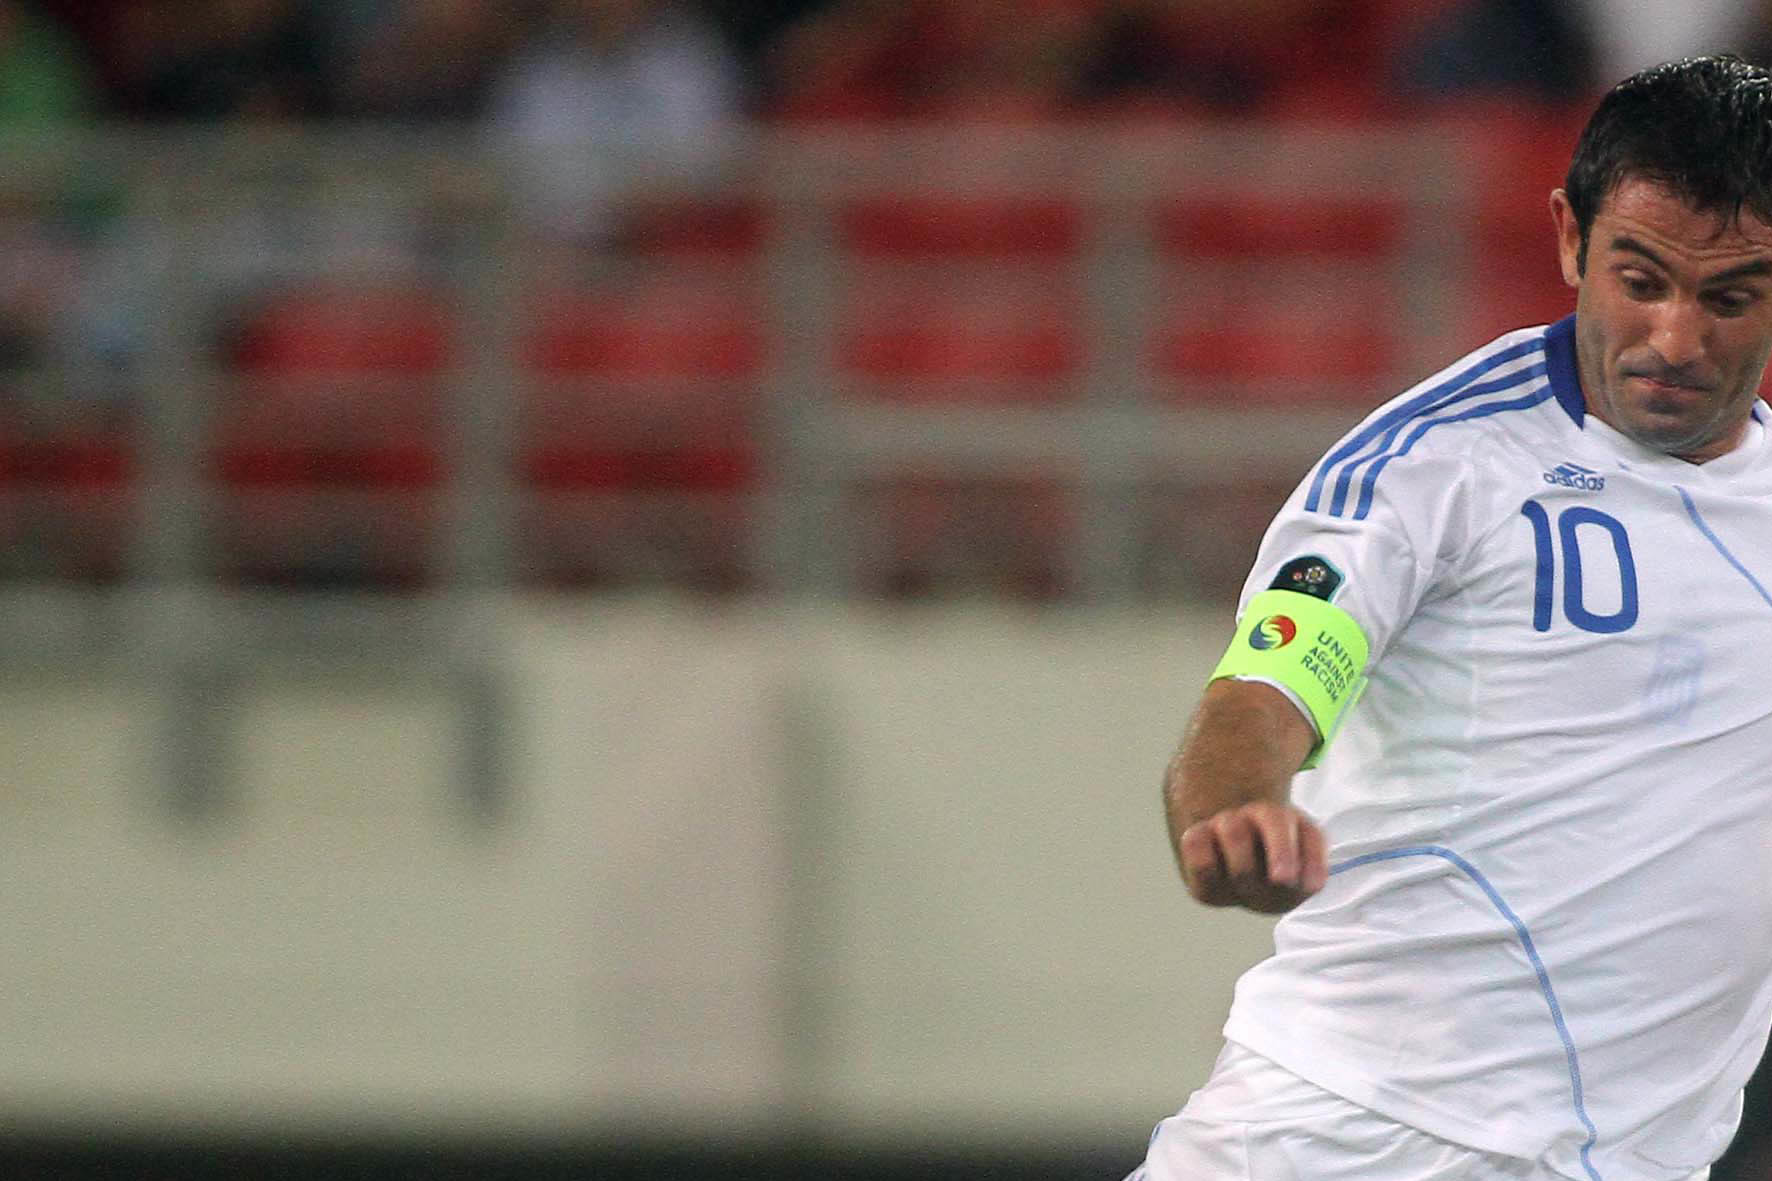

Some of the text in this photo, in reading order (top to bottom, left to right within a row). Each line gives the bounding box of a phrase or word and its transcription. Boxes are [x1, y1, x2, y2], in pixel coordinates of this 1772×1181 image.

[1543, 472, 1605, 490] adidas
[1520, 499, 1639, 634] 10
[1317, 630, 1355, 684] UNITE
